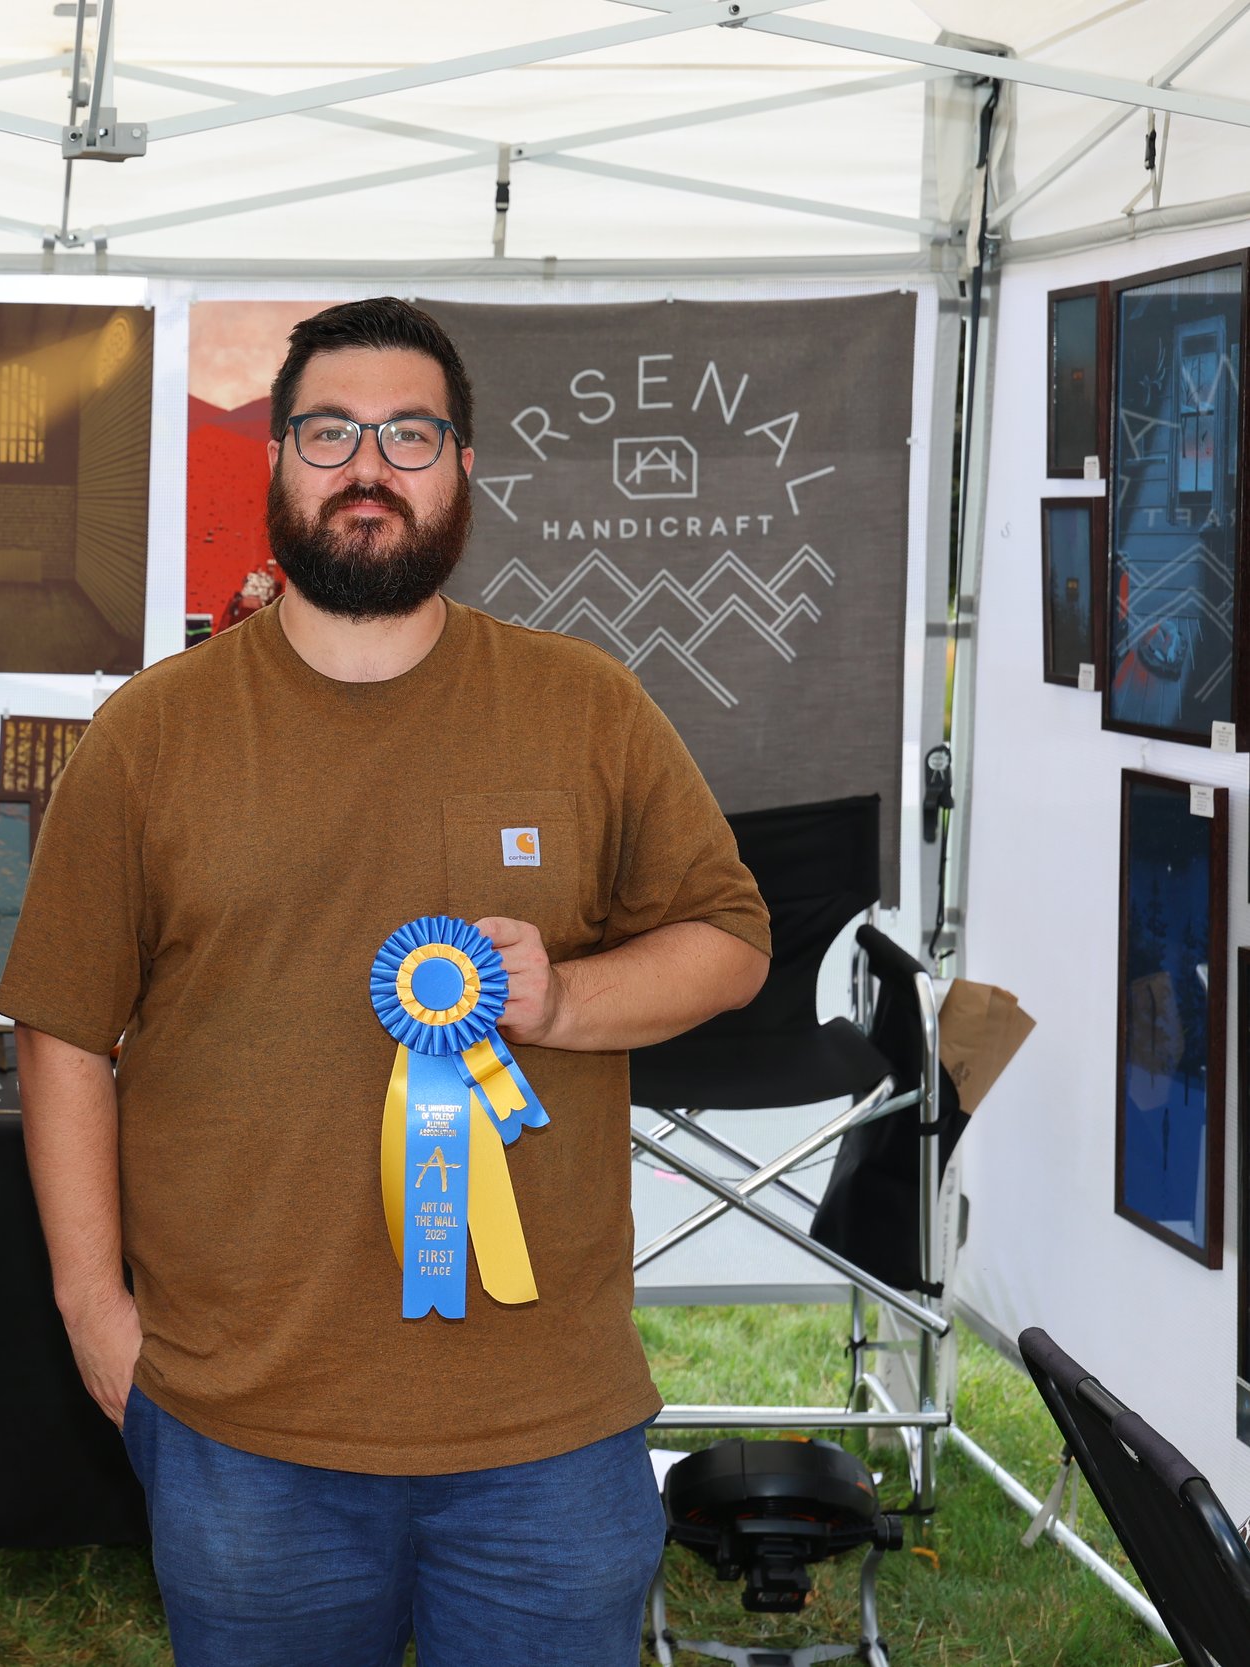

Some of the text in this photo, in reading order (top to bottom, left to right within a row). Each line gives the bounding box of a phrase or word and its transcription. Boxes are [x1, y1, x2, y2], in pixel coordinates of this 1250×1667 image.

[476, 353, 836, 522] ARSENAL
[542, 514, 775, 541] HANDICRAFT
[415, 1104, 462, 1113] THE UNIVERSITY
[421, 1112, 455, 1121] OF TOLEDO
[420, 1202, 453, 1213] ART ON
[414, 1215, 458, 1228] THE MALL
[424, 1229, 447, 1241] 2025
[418, 1249, 454, 1263] FIRST
[420, 1266, 451, 1276] PLACE
